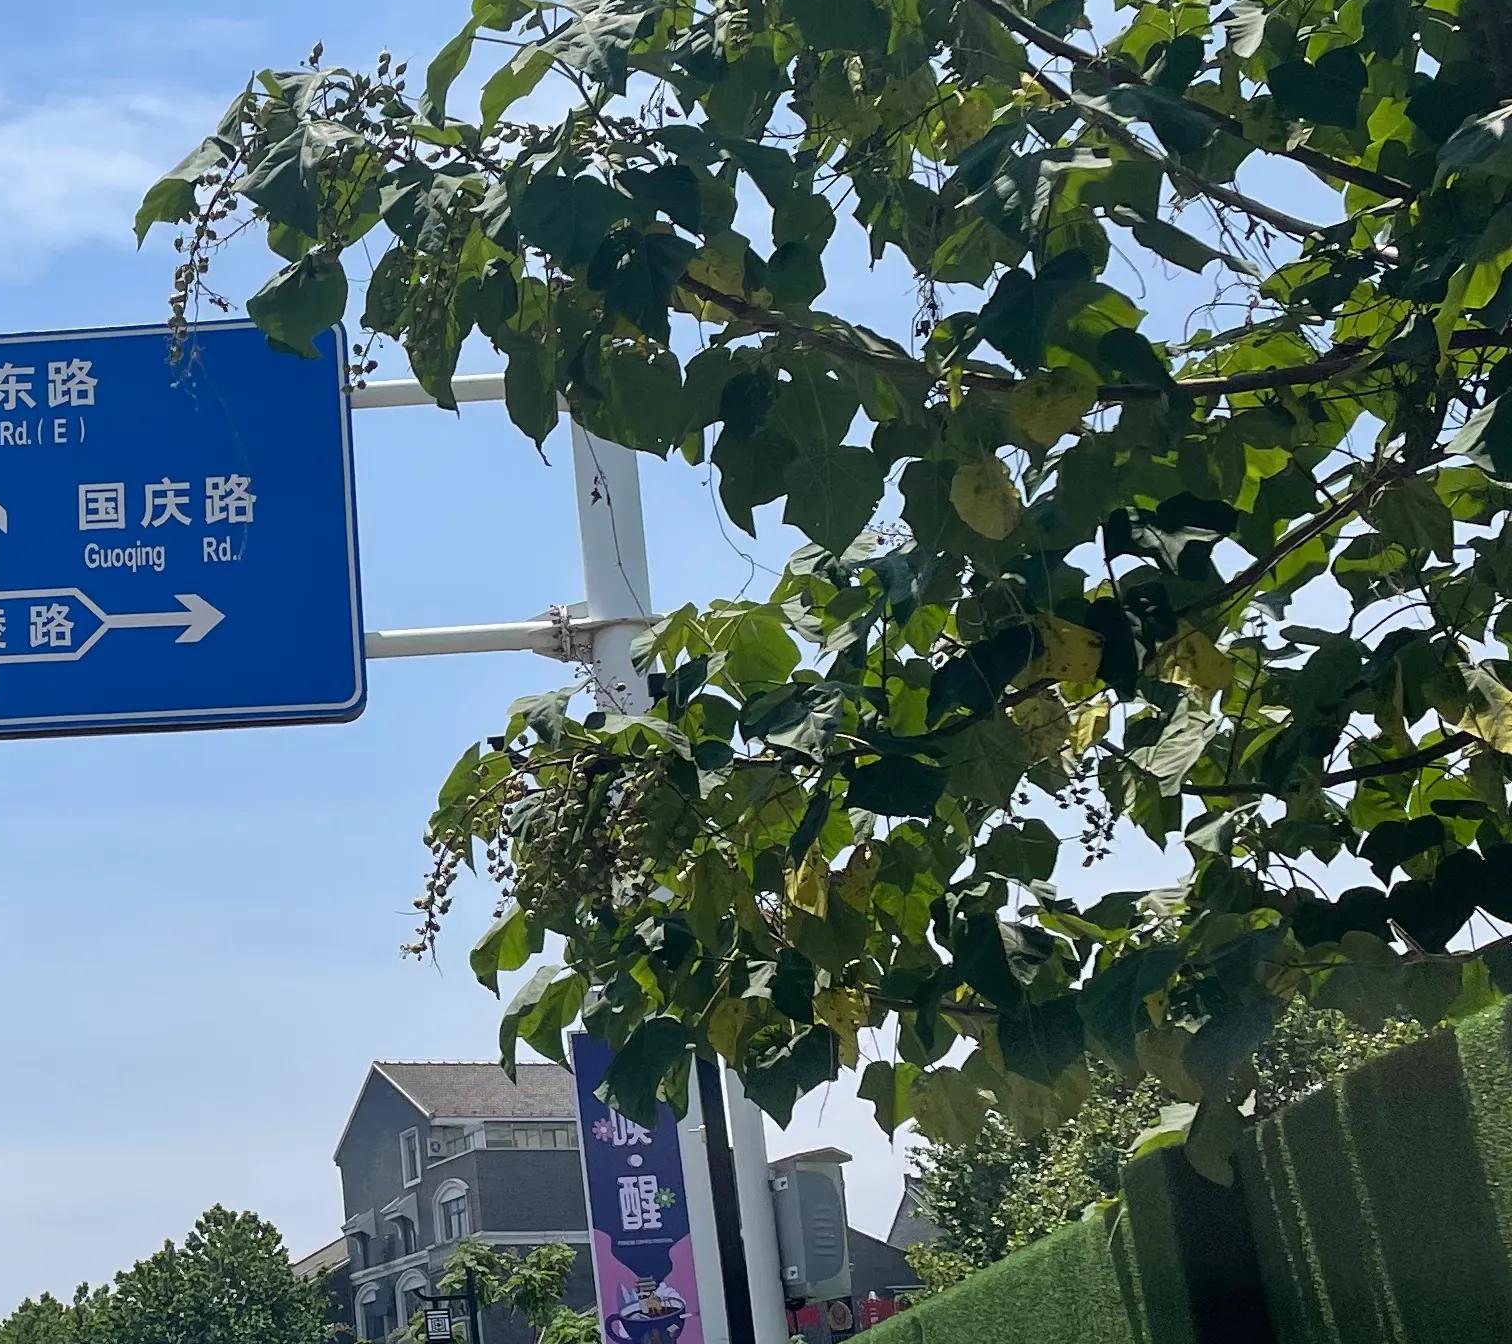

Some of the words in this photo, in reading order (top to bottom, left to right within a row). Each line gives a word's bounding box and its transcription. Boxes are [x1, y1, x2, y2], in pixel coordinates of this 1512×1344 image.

[78, 473, 257, 531] 国庆路
[84, 540, 165, 572] Guoqing
[203, 536, 239, 562] Rd.
